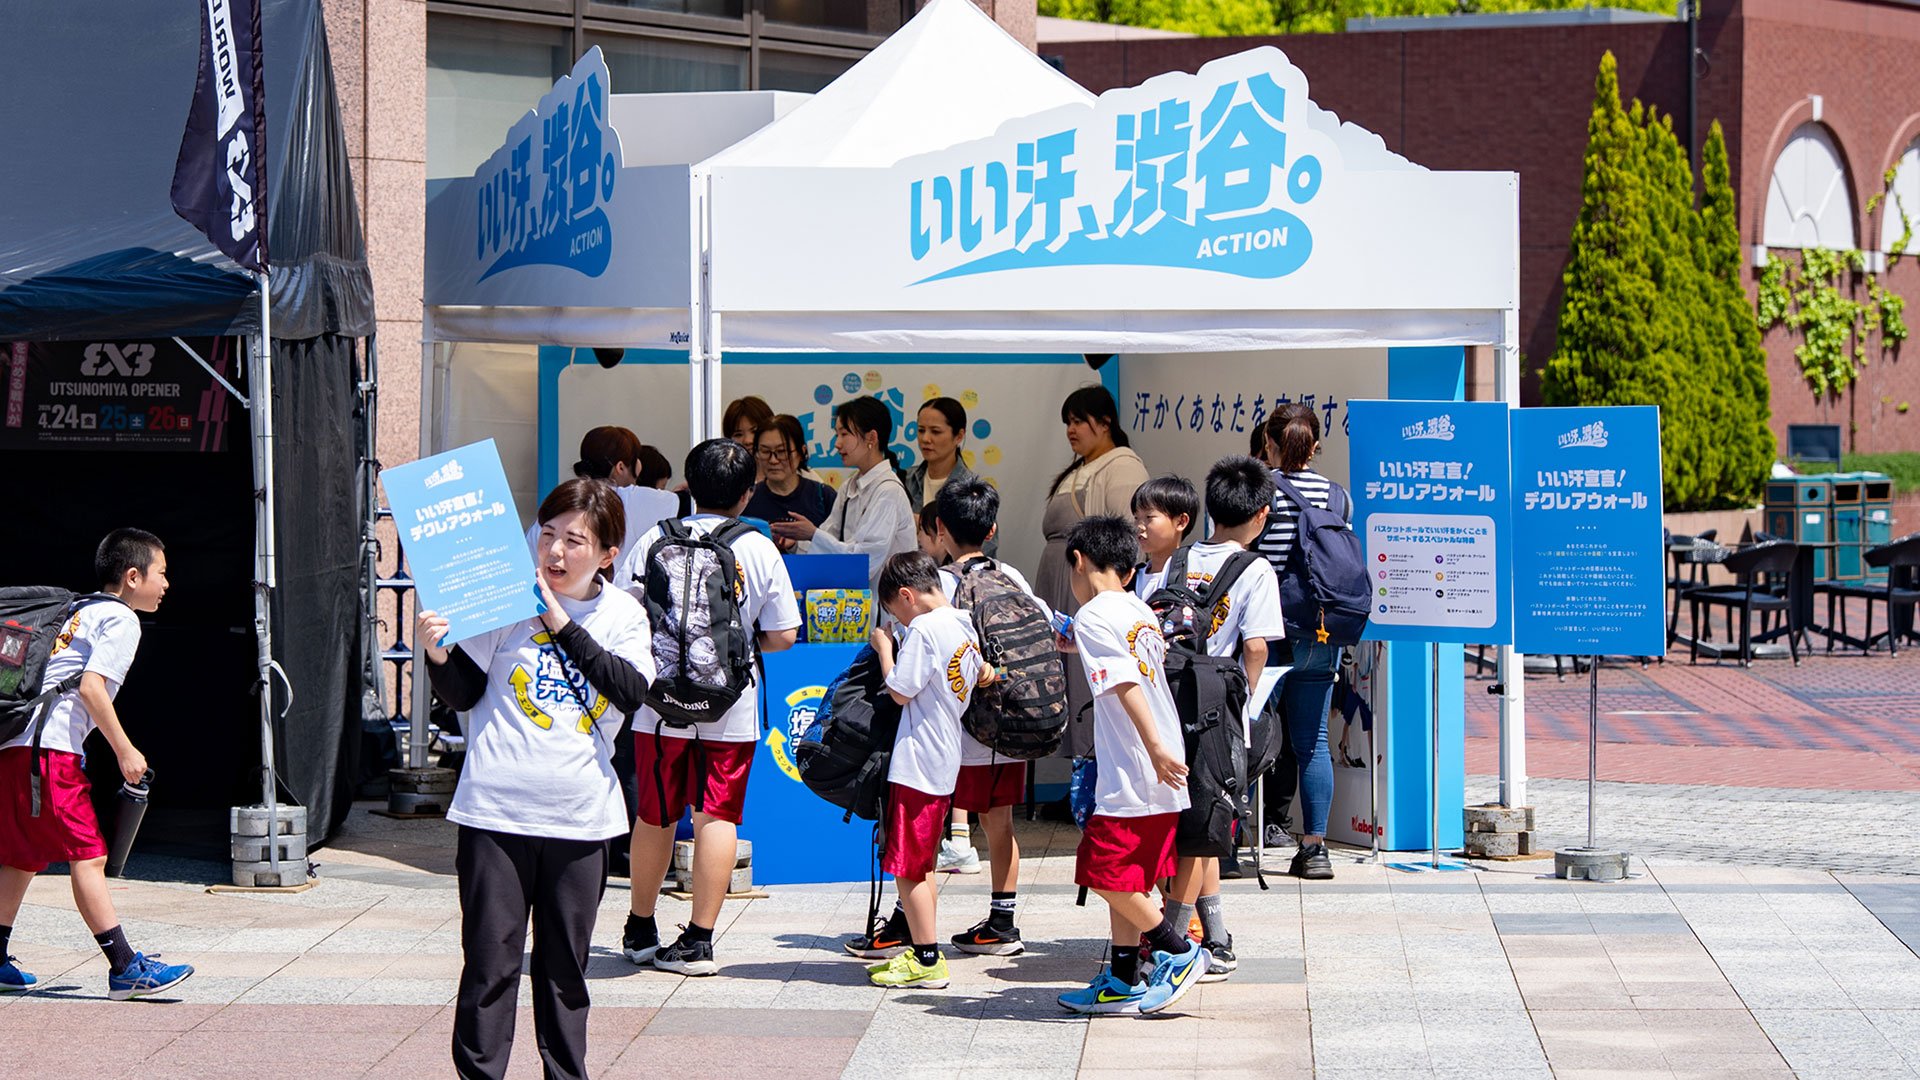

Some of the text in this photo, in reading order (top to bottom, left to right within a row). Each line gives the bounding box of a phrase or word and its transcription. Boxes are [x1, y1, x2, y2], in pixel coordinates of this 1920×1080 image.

[569, 225, 603, 258] ACTION
[1196, 226, 1288, 259] ACTION
[50, 382, 180, 397] UTSUNOMIYA OPENER
[100, 405, 127, 430] 25
[149, 405, 175, 430] 26
[1133, 392, 1350, 437] 汗かくあなたをす
[1366, 481, 1495, 502] デクレアウォール
[1525, 491, 1647, 510] デクレアウォール
[410, 502, 506, 542] デクレアウォール
[663, 693, 710, 710] SPALDING
